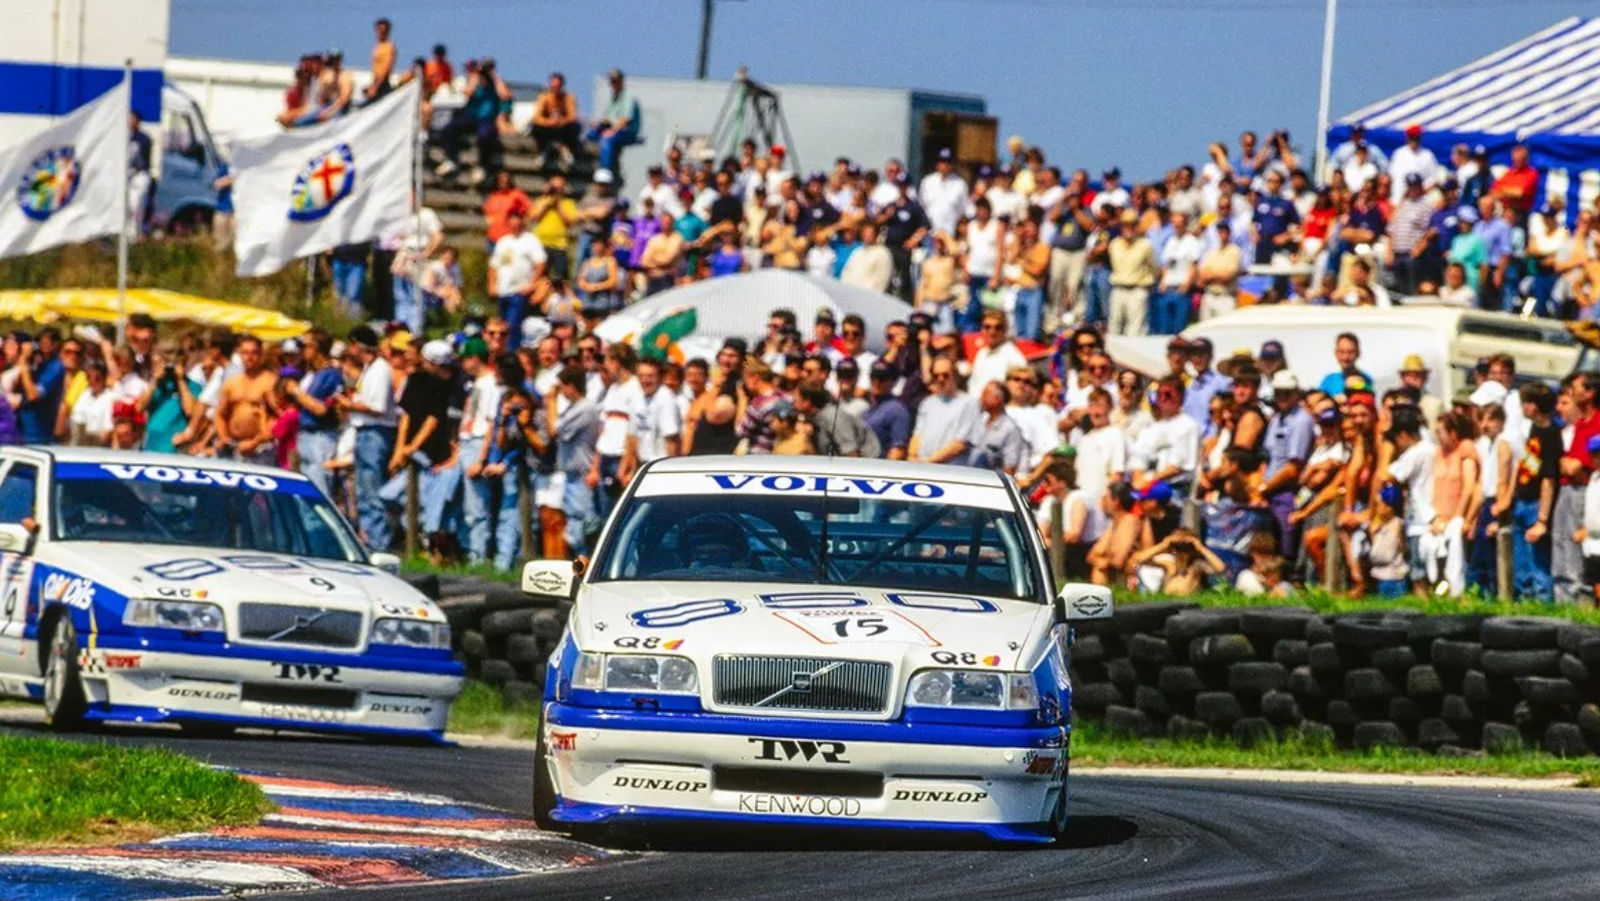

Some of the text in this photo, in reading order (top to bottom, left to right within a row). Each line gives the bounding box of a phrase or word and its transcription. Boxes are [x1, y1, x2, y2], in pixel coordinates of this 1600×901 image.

[100, 465, 278, 491] VOLVO
[705, 474, 945, 499] VOLVO
[628, 591, 1002, 629] 850
[832, 618, 889, 638] 15
[613, 636, 662, 650] Q8
[931, 650, 978, 666] Q8
[271, 662, 343, 683] TWR
[168, 687, 238, 700] DUNLOP
[370, 702, 433, 715] DUNLOP
[748, 738, 850, 764] TWR
[613, 776, 708, 793] DUNLOP
[738, 793, 861, 817] KENWOOD
[893, 790, 988, 803] DUNLOP
